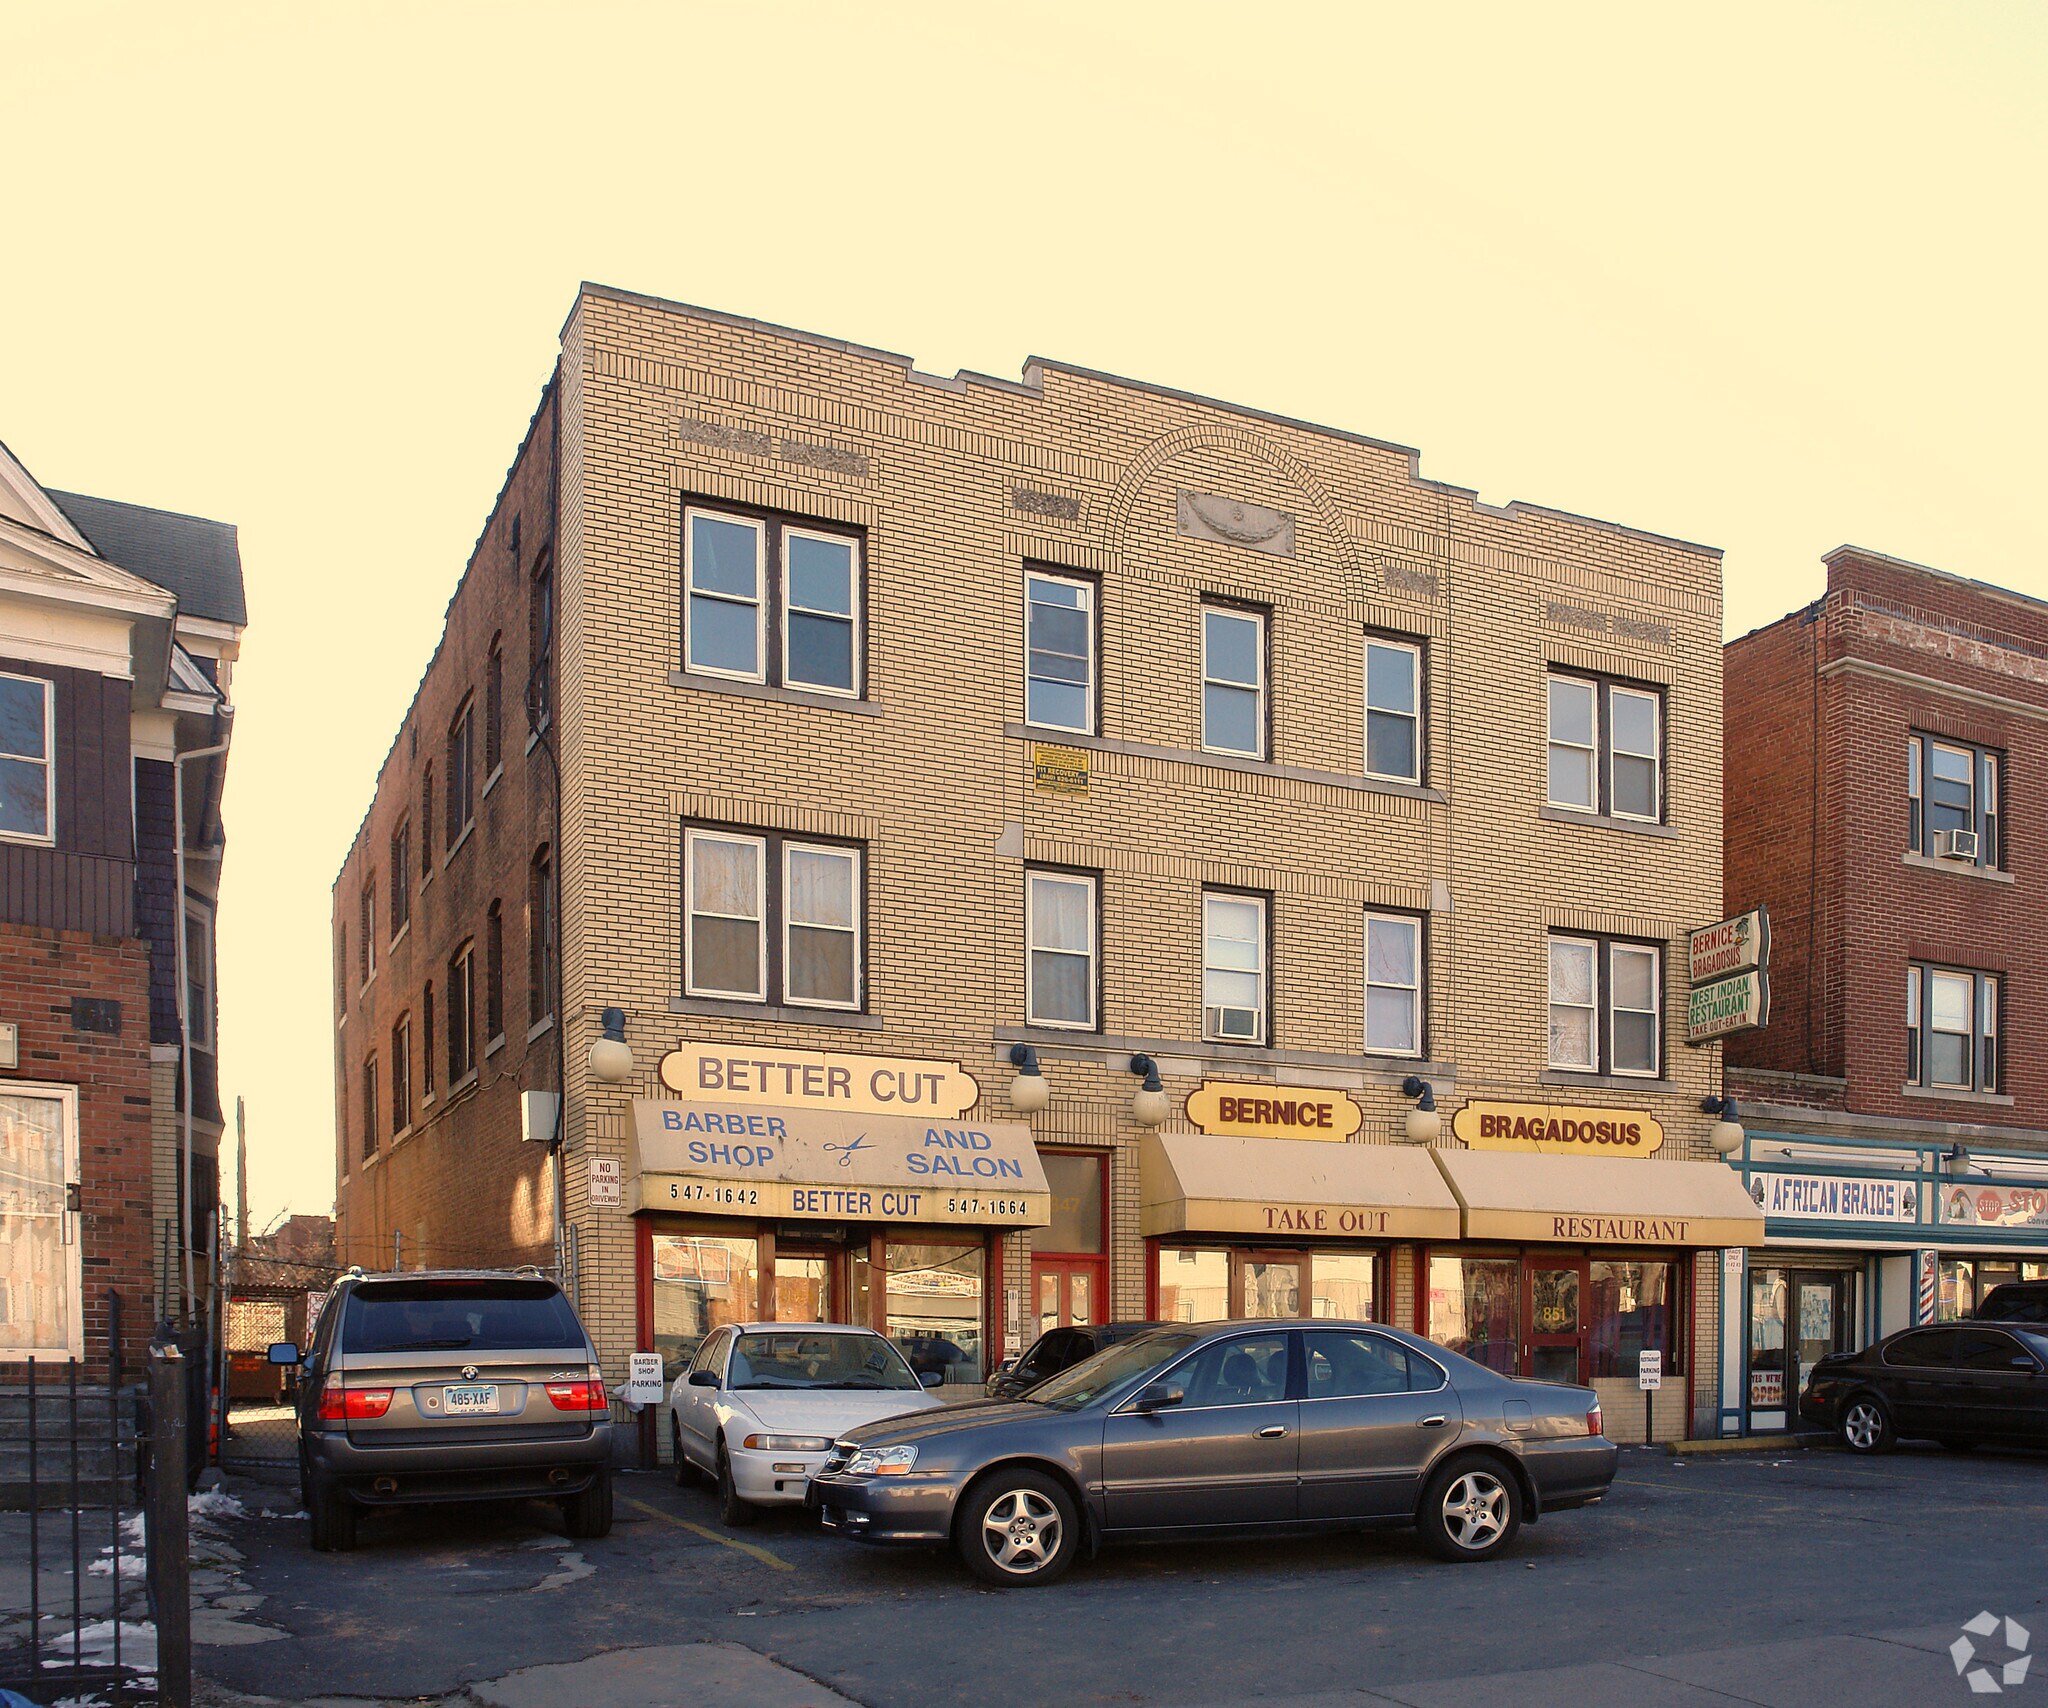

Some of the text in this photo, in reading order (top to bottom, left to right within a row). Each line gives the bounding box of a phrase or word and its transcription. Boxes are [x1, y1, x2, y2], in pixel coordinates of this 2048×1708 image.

[1692, 925, 1734, 955] BERNICE
[1692, 946, 1741, 978] BRAGADOSUS
[1691, 976, 1749, 1006] WEST INDIAN
[1690, 991, 1751, 1026] RESTAURANT
[1691, 1025, 1708, 1036] TAKE
[1739, 1012, 1747, 1023] IN
[699, 1056, 946, 1105] BETTER CUT
[1219, 1096, 1334, 1129] BERNICE
[662, 1110, 992, 1152] BARBER AND
[1479, 1113, 1642, 1146] BRAGADOSUS
[599, 1162, 611, 1173] NO
[687, 1141, 1024, 1179] SHOP SALON
[591, 1175, 619, 1184] PARKING
[601, 1185, 609, 1194] IN
[590, 1195, 619, 1203] DRIVEWAY
[670, 1183, 1027, 1216] 547-1642 BETTER CUT 547-1664
[1772, 1178, 1895, 1216] AFRICAN BRAIDS
[1979, 1199, 2000, 1213] STOP
[2009, 1189, 2048, 1214] STO
[1262, 1206, 1391, 1233] TAKE OUT
[1552, 1216, 1690, 1242] RESTAURANT
[1542, 1307, 1566, 1322] 851
[633, 1357, 659, 1366] BARBER
[638, 1367, 656, 1375] SHOP
[631, 1380, 662, 1388] PARKING
[1752, 1374, 1782, 1383] YES WE'RE
[1752, 1386, 1781, 1402] OPEN
